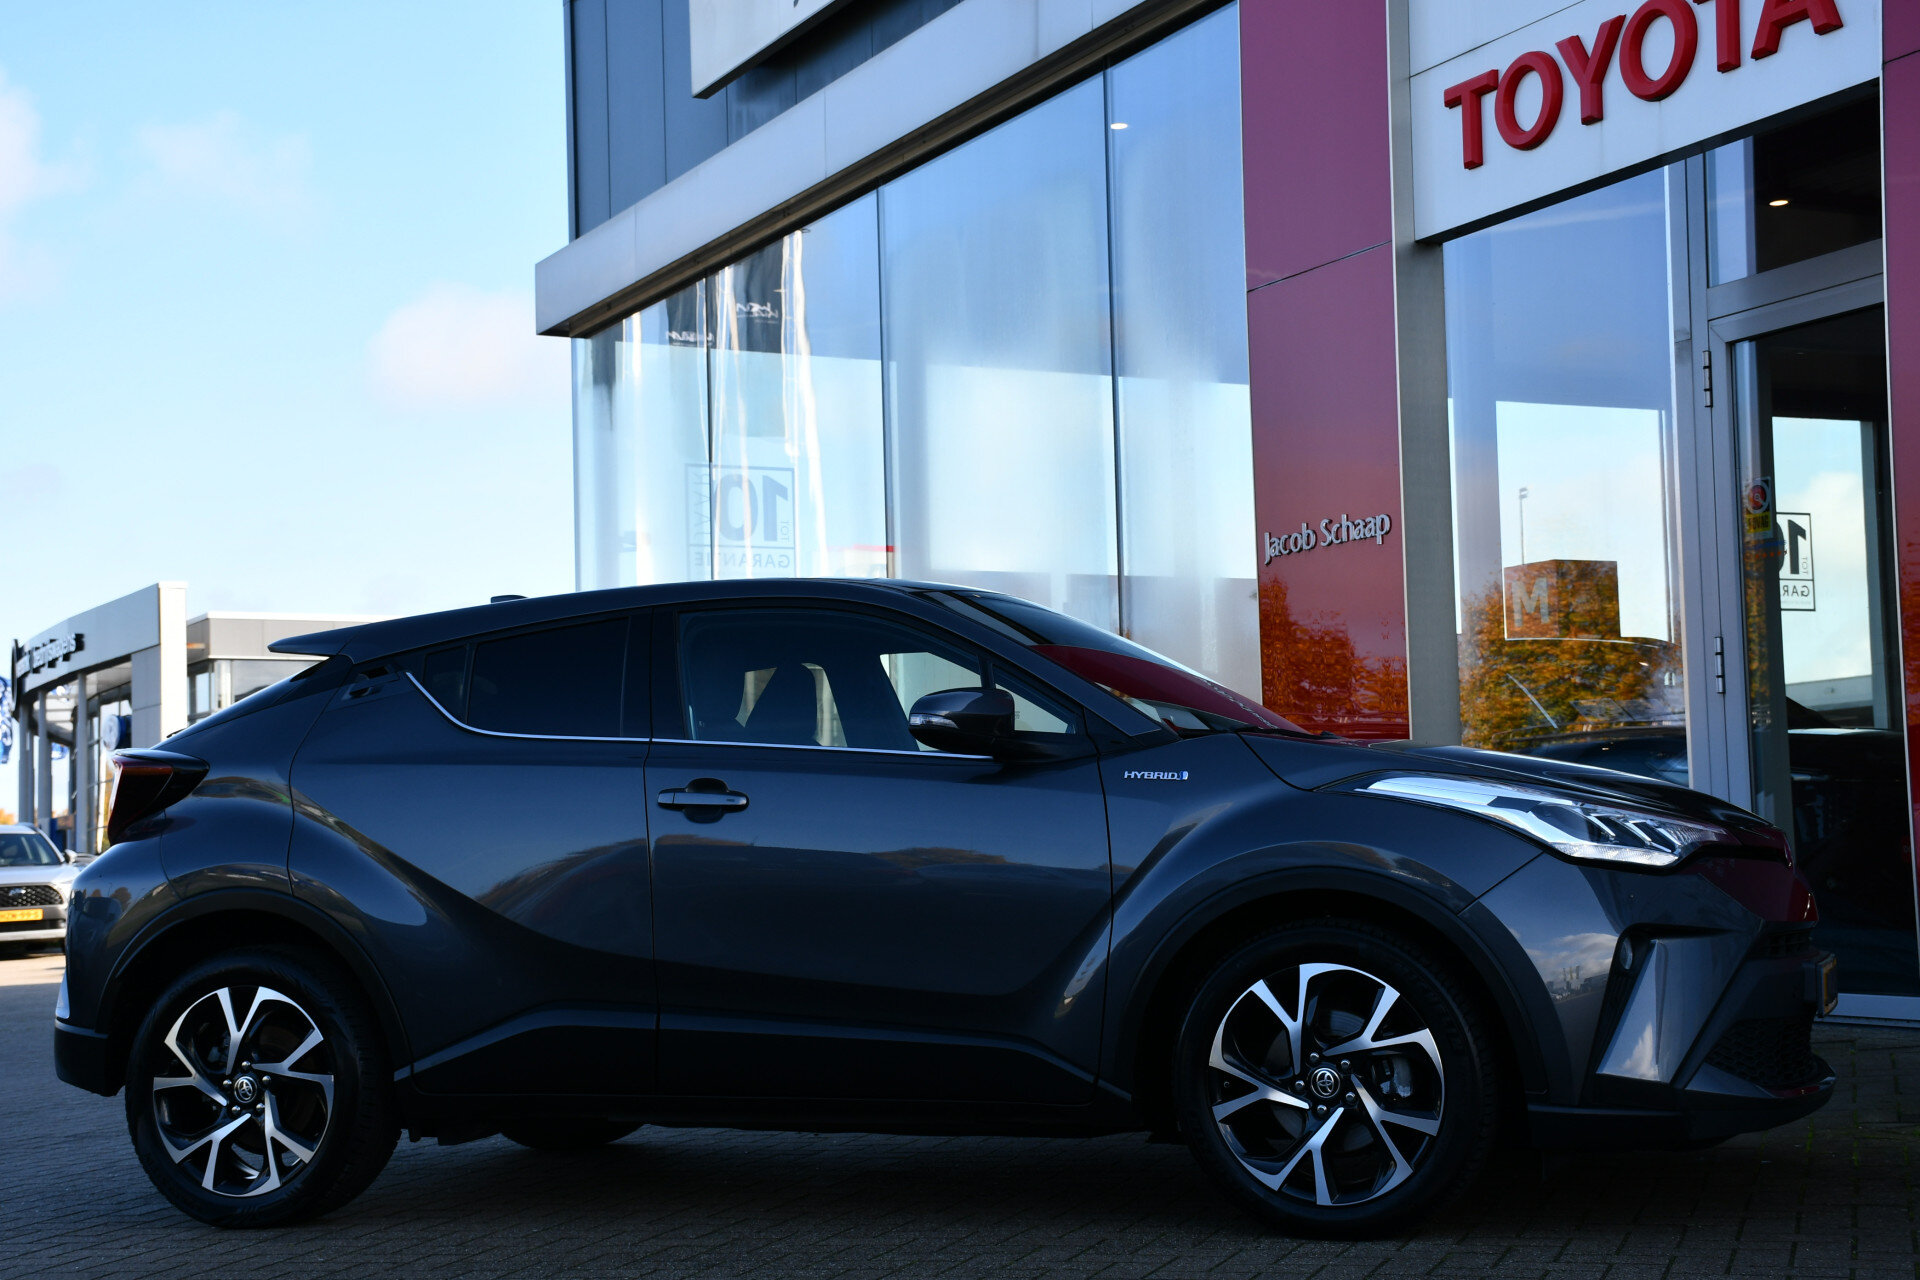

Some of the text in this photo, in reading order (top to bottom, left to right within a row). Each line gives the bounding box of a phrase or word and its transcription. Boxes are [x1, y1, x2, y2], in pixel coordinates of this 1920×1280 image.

[1444, 0, 1843, 170] TOYOTA
[1264, 513, 1392, 565] Jacob Schaap
[1124, 771, 1178, 780] HYBRID
